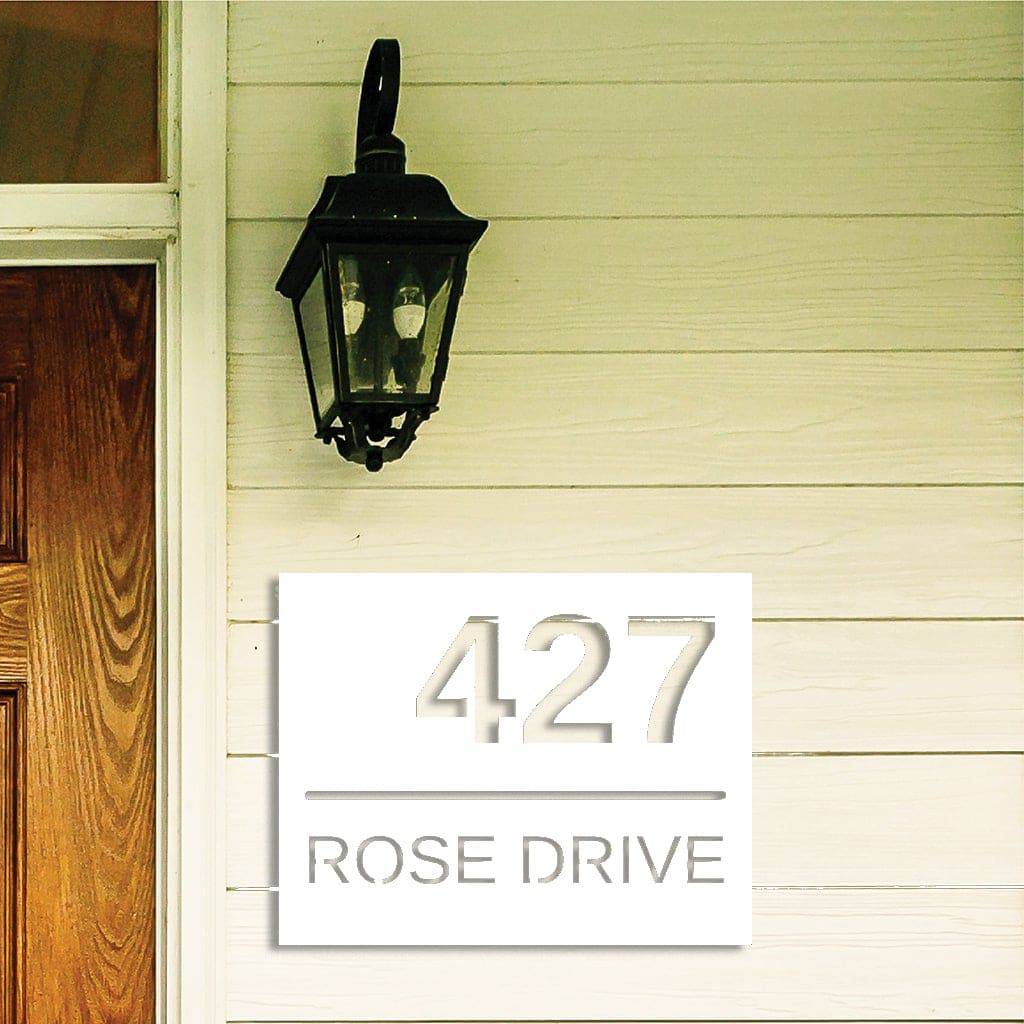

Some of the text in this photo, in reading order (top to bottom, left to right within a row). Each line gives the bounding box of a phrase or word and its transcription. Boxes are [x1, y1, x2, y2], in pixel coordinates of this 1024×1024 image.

[415, 613, 717, 744] 427
[308, 835, 726, 885] ROSE DRIVE
